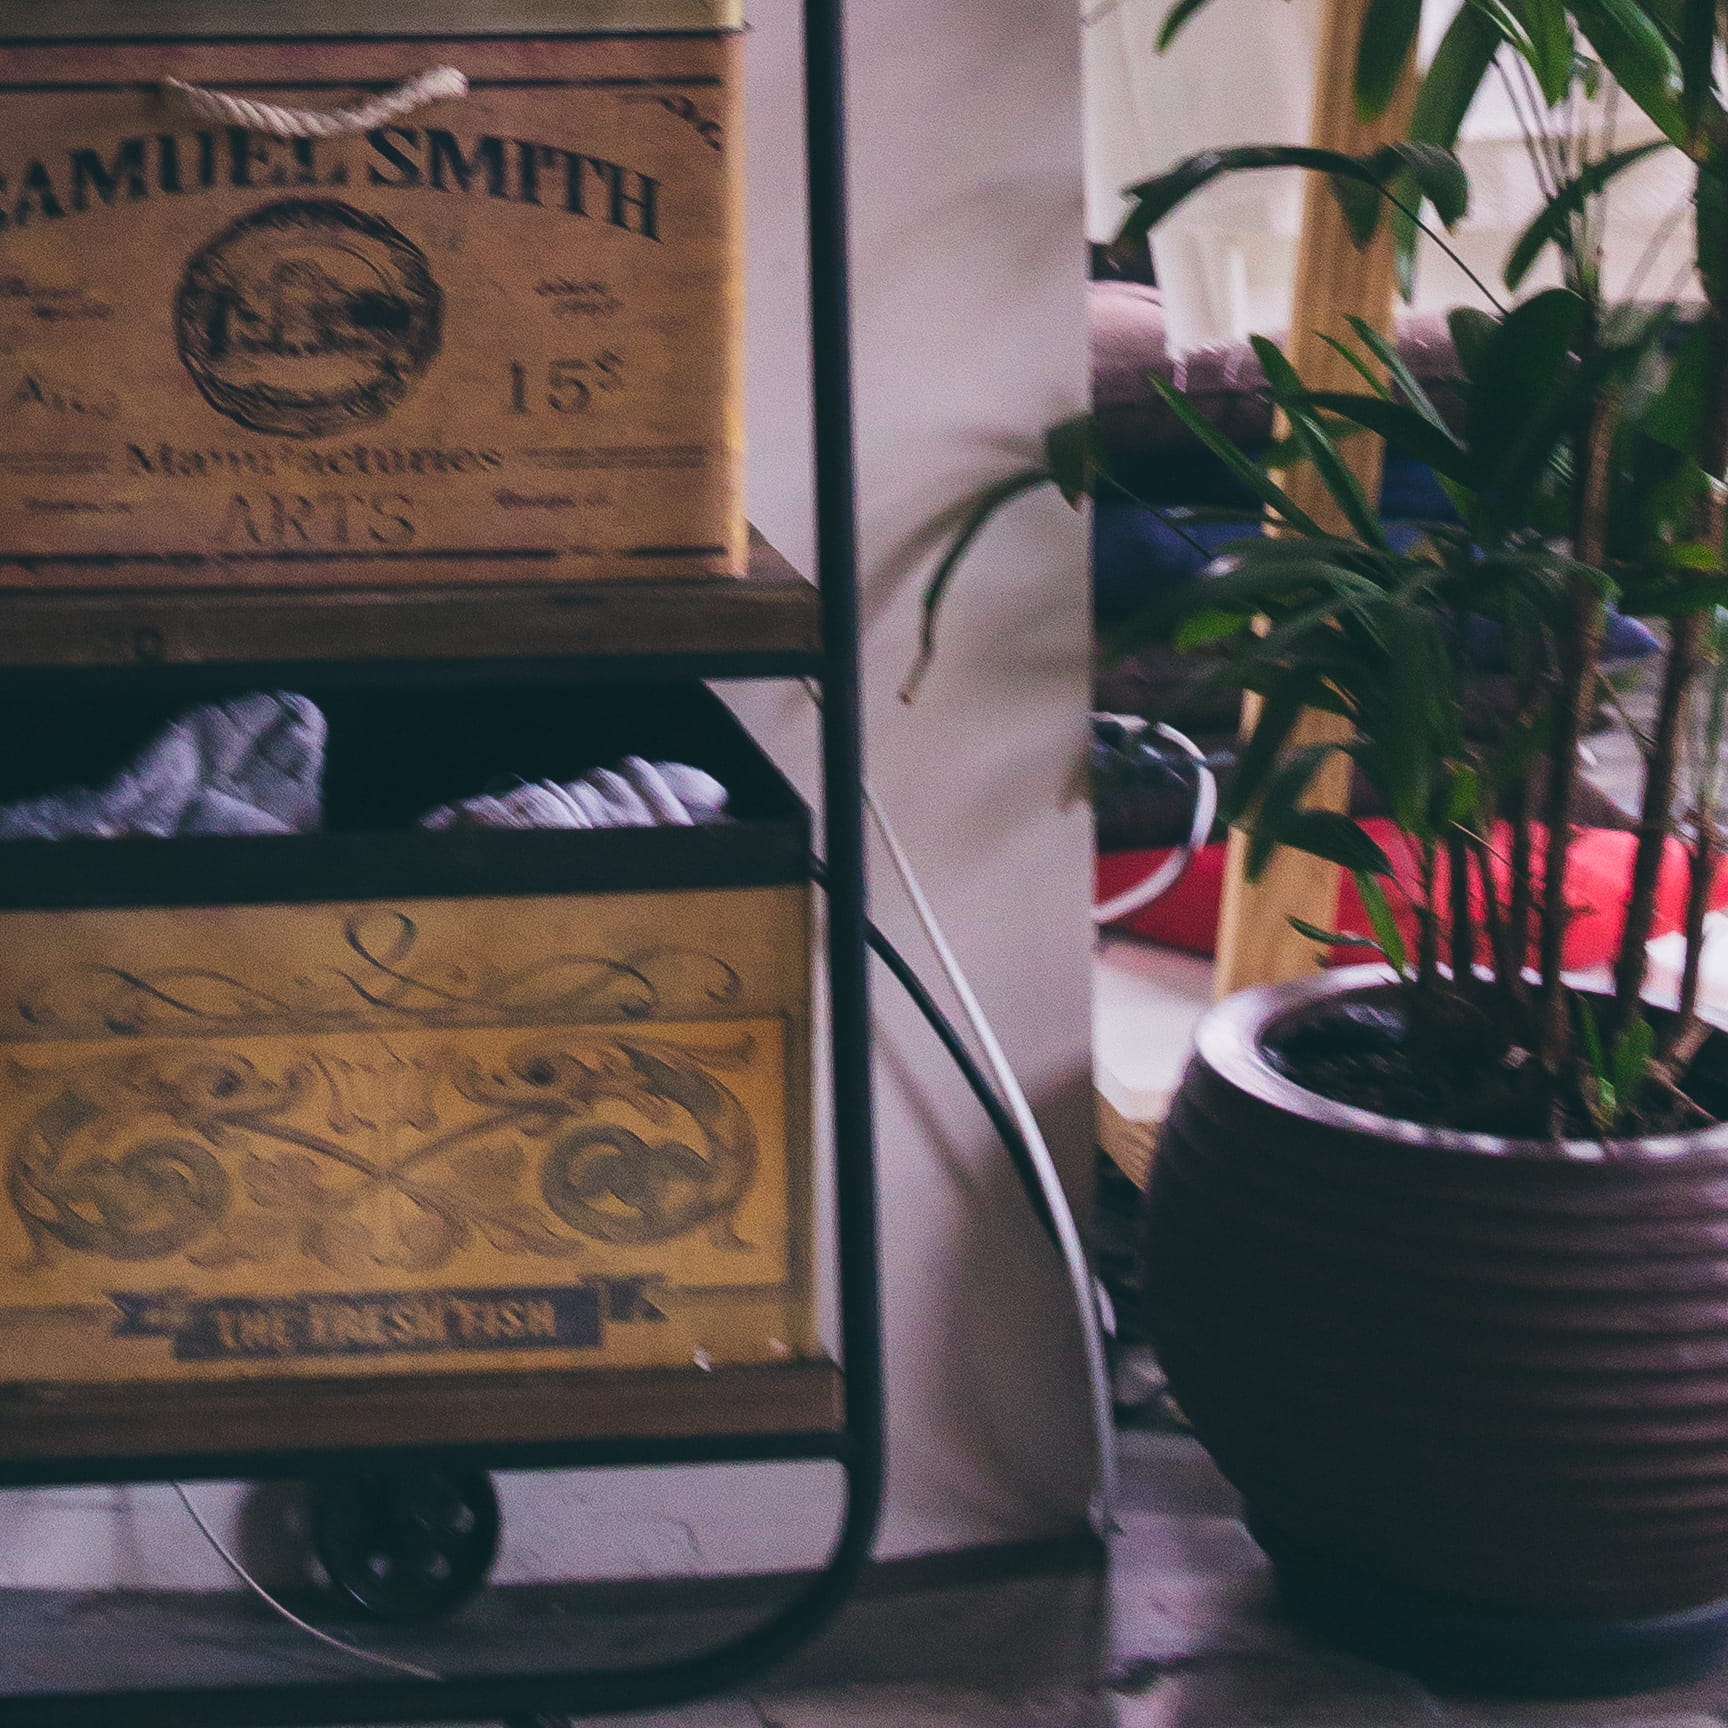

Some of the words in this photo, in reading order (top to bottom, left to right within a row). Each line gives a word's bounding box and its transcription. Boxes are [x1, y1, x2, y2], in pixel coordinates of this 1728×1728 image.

[367, 126, 662, 244] SMITH
[212, 491, 415, 544] ARTS
[450, 1297, 556, 1339] FISH
